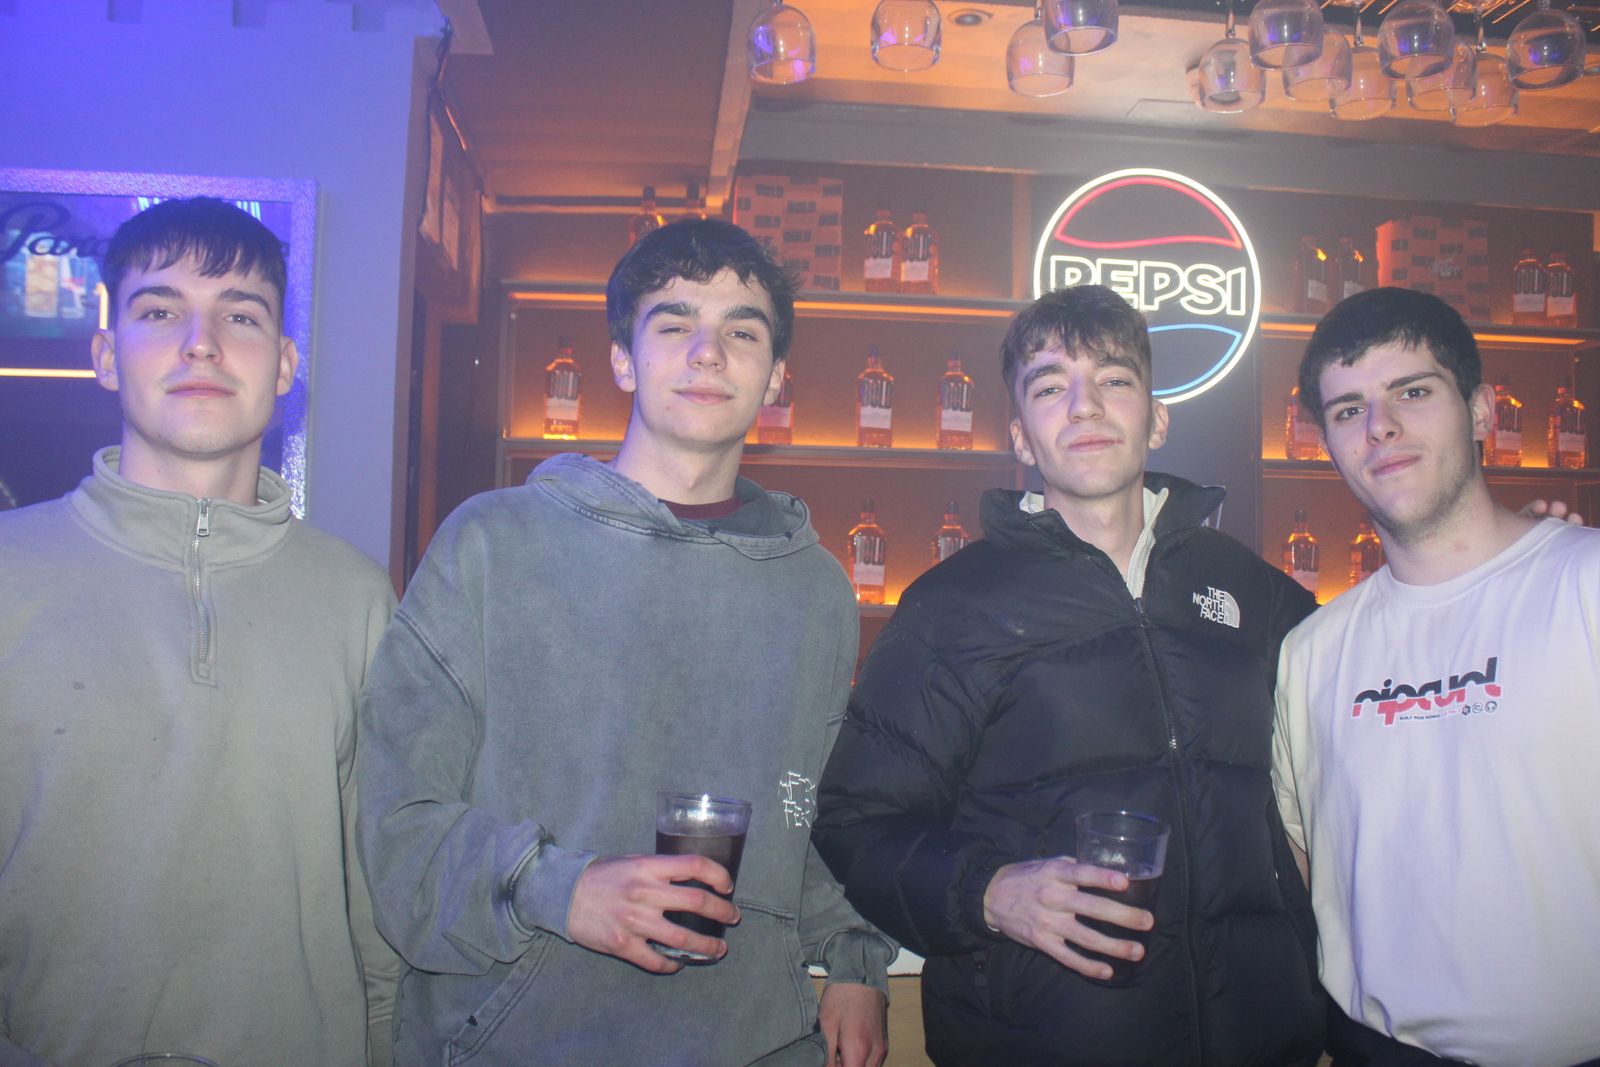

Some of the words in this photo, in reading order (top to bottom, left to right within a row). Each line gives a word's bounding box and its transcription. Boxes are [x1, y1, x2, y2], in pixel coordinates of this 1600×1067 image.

[1051, 255, 1247, 315] PEPSI
[1192, 592, 1225, 613] NORTH
[1207, 585, 1226, 602] THE
[1200, 606, 1225, 624] FACE
